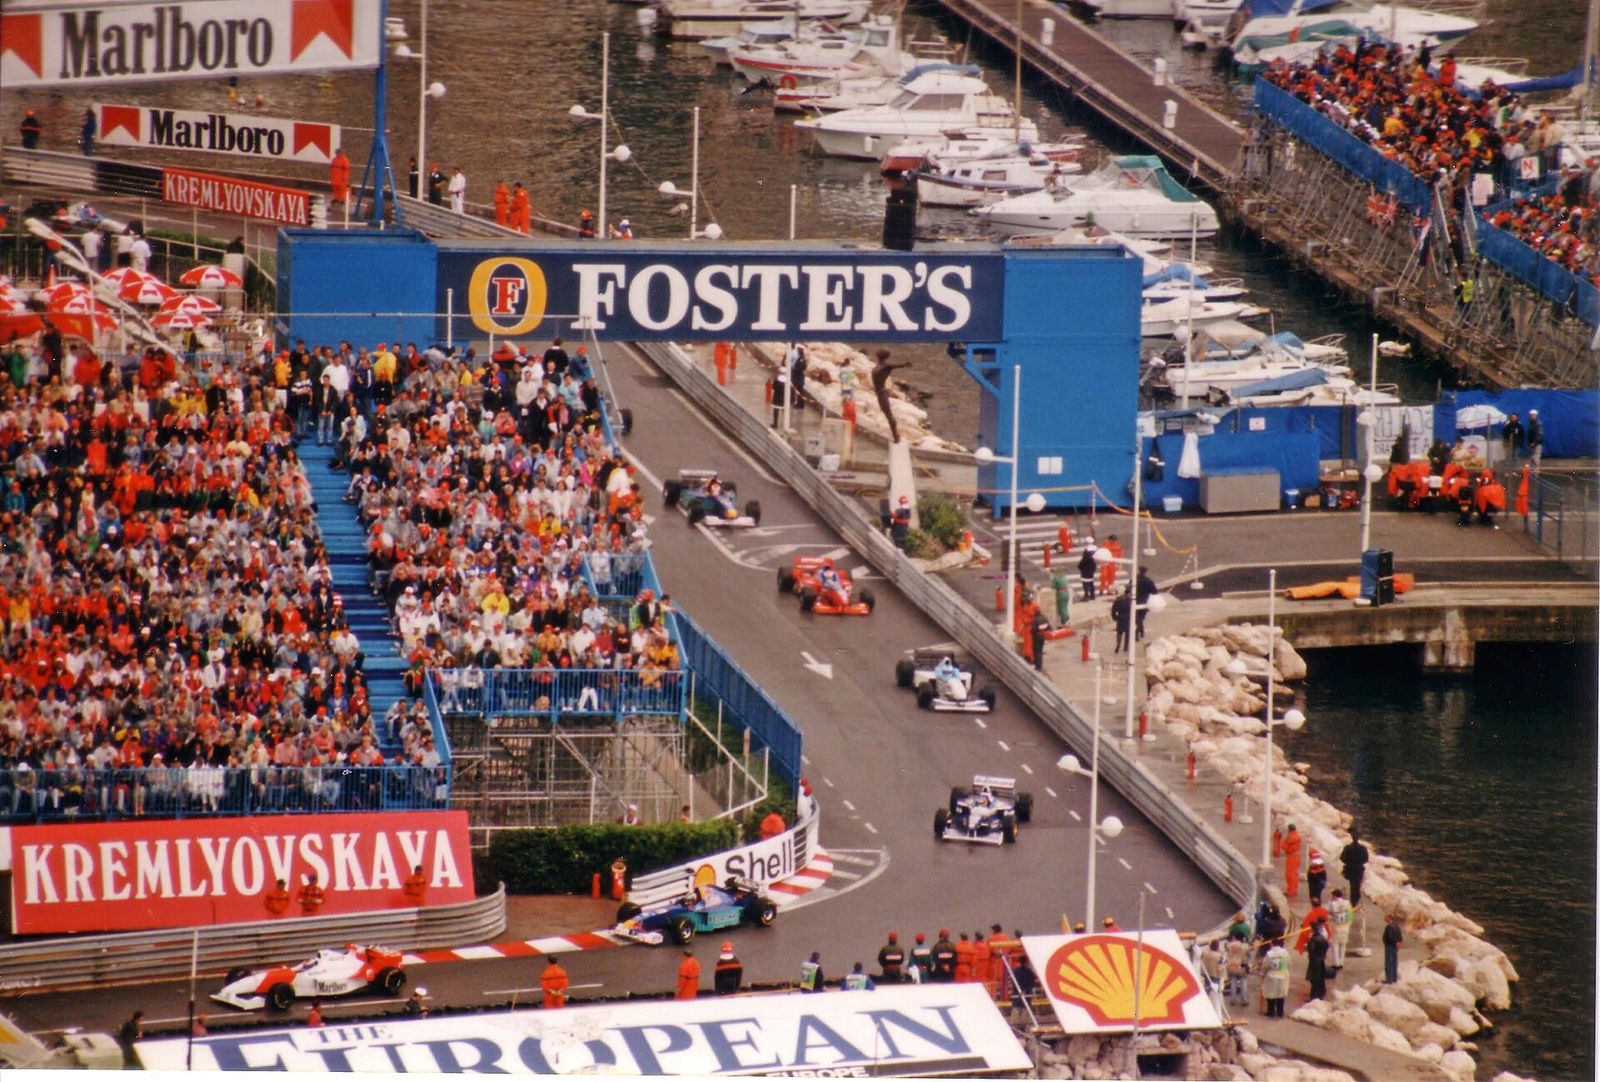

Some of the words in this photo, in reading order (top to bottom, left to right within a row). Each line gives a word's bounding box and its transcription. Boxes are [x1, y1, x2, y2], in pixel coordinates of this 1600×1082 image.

[60, 6, 273, 79] Marlboro
[149, 110, 285, 155] Marlboro
[164, 173, 306, 224] KREMLYOVSKAYA
[571, 262, 972, 332] FOSTER'S
[21, 829, 464, 905] KREMLYOVSKAYA
[726, 839, 792, 879] Shell
[311, 1026, 393, 1043] THE
